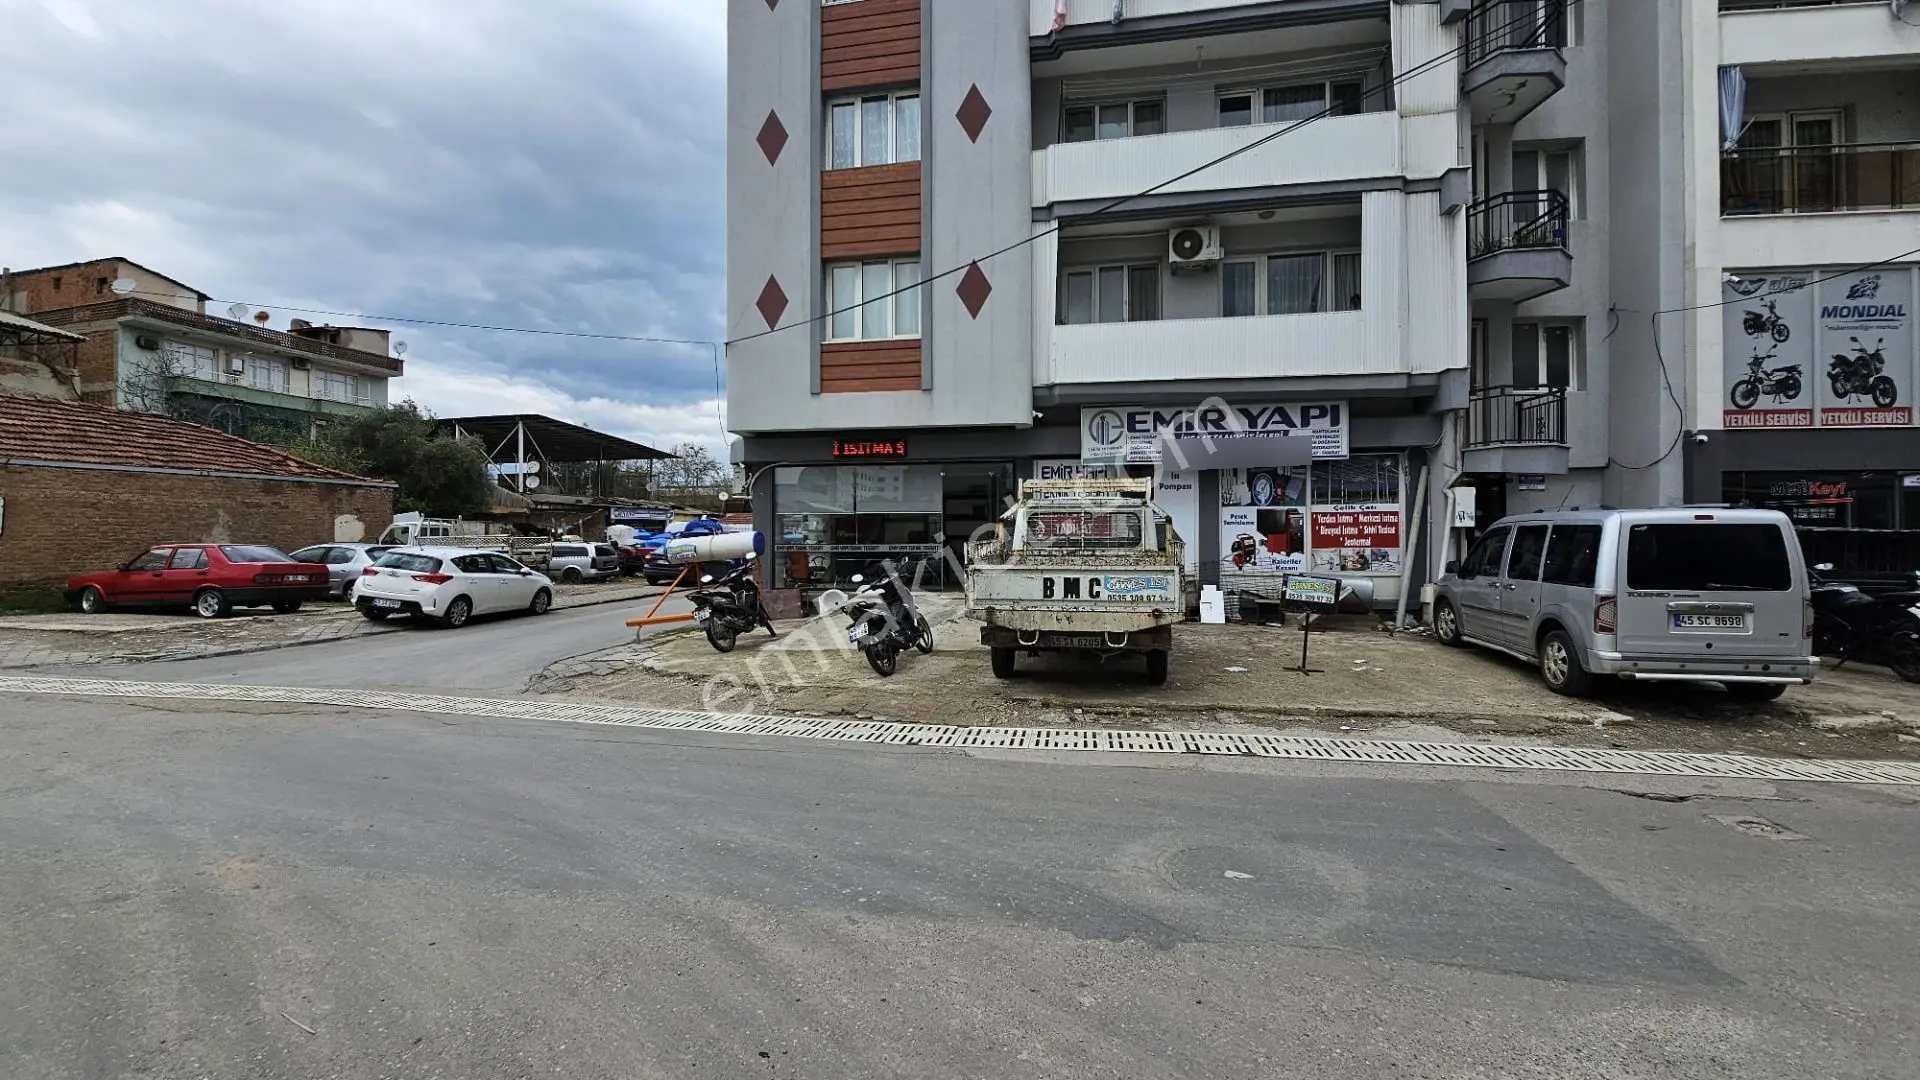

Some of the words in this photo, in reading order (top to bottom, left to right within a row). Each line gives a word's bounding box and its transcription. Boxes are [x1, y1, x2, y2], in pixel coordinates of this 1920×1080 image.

[1237, 404, 1340, 430] YAPI
[1724, 413, 1764, 426] YETKİLİ
[1766, 412, 1810, 426] SERVİSİ
[1821, 410, 1861, 425] YETKİLİ
[1864, 409, 1909, 424] SERVİSİ
[1041, 463, 1072, 479] EMİR
[1318, 513, 1336, 523] Yerden
[1320, 525, 1341, 536] Bireysel
[1344, 537, 1371, 547] Jeotermal
[1681, 616, 1694, 626] 45
[1697, 616, 1711, 626] SC
[1715, 616, 1742, 626] 8698
